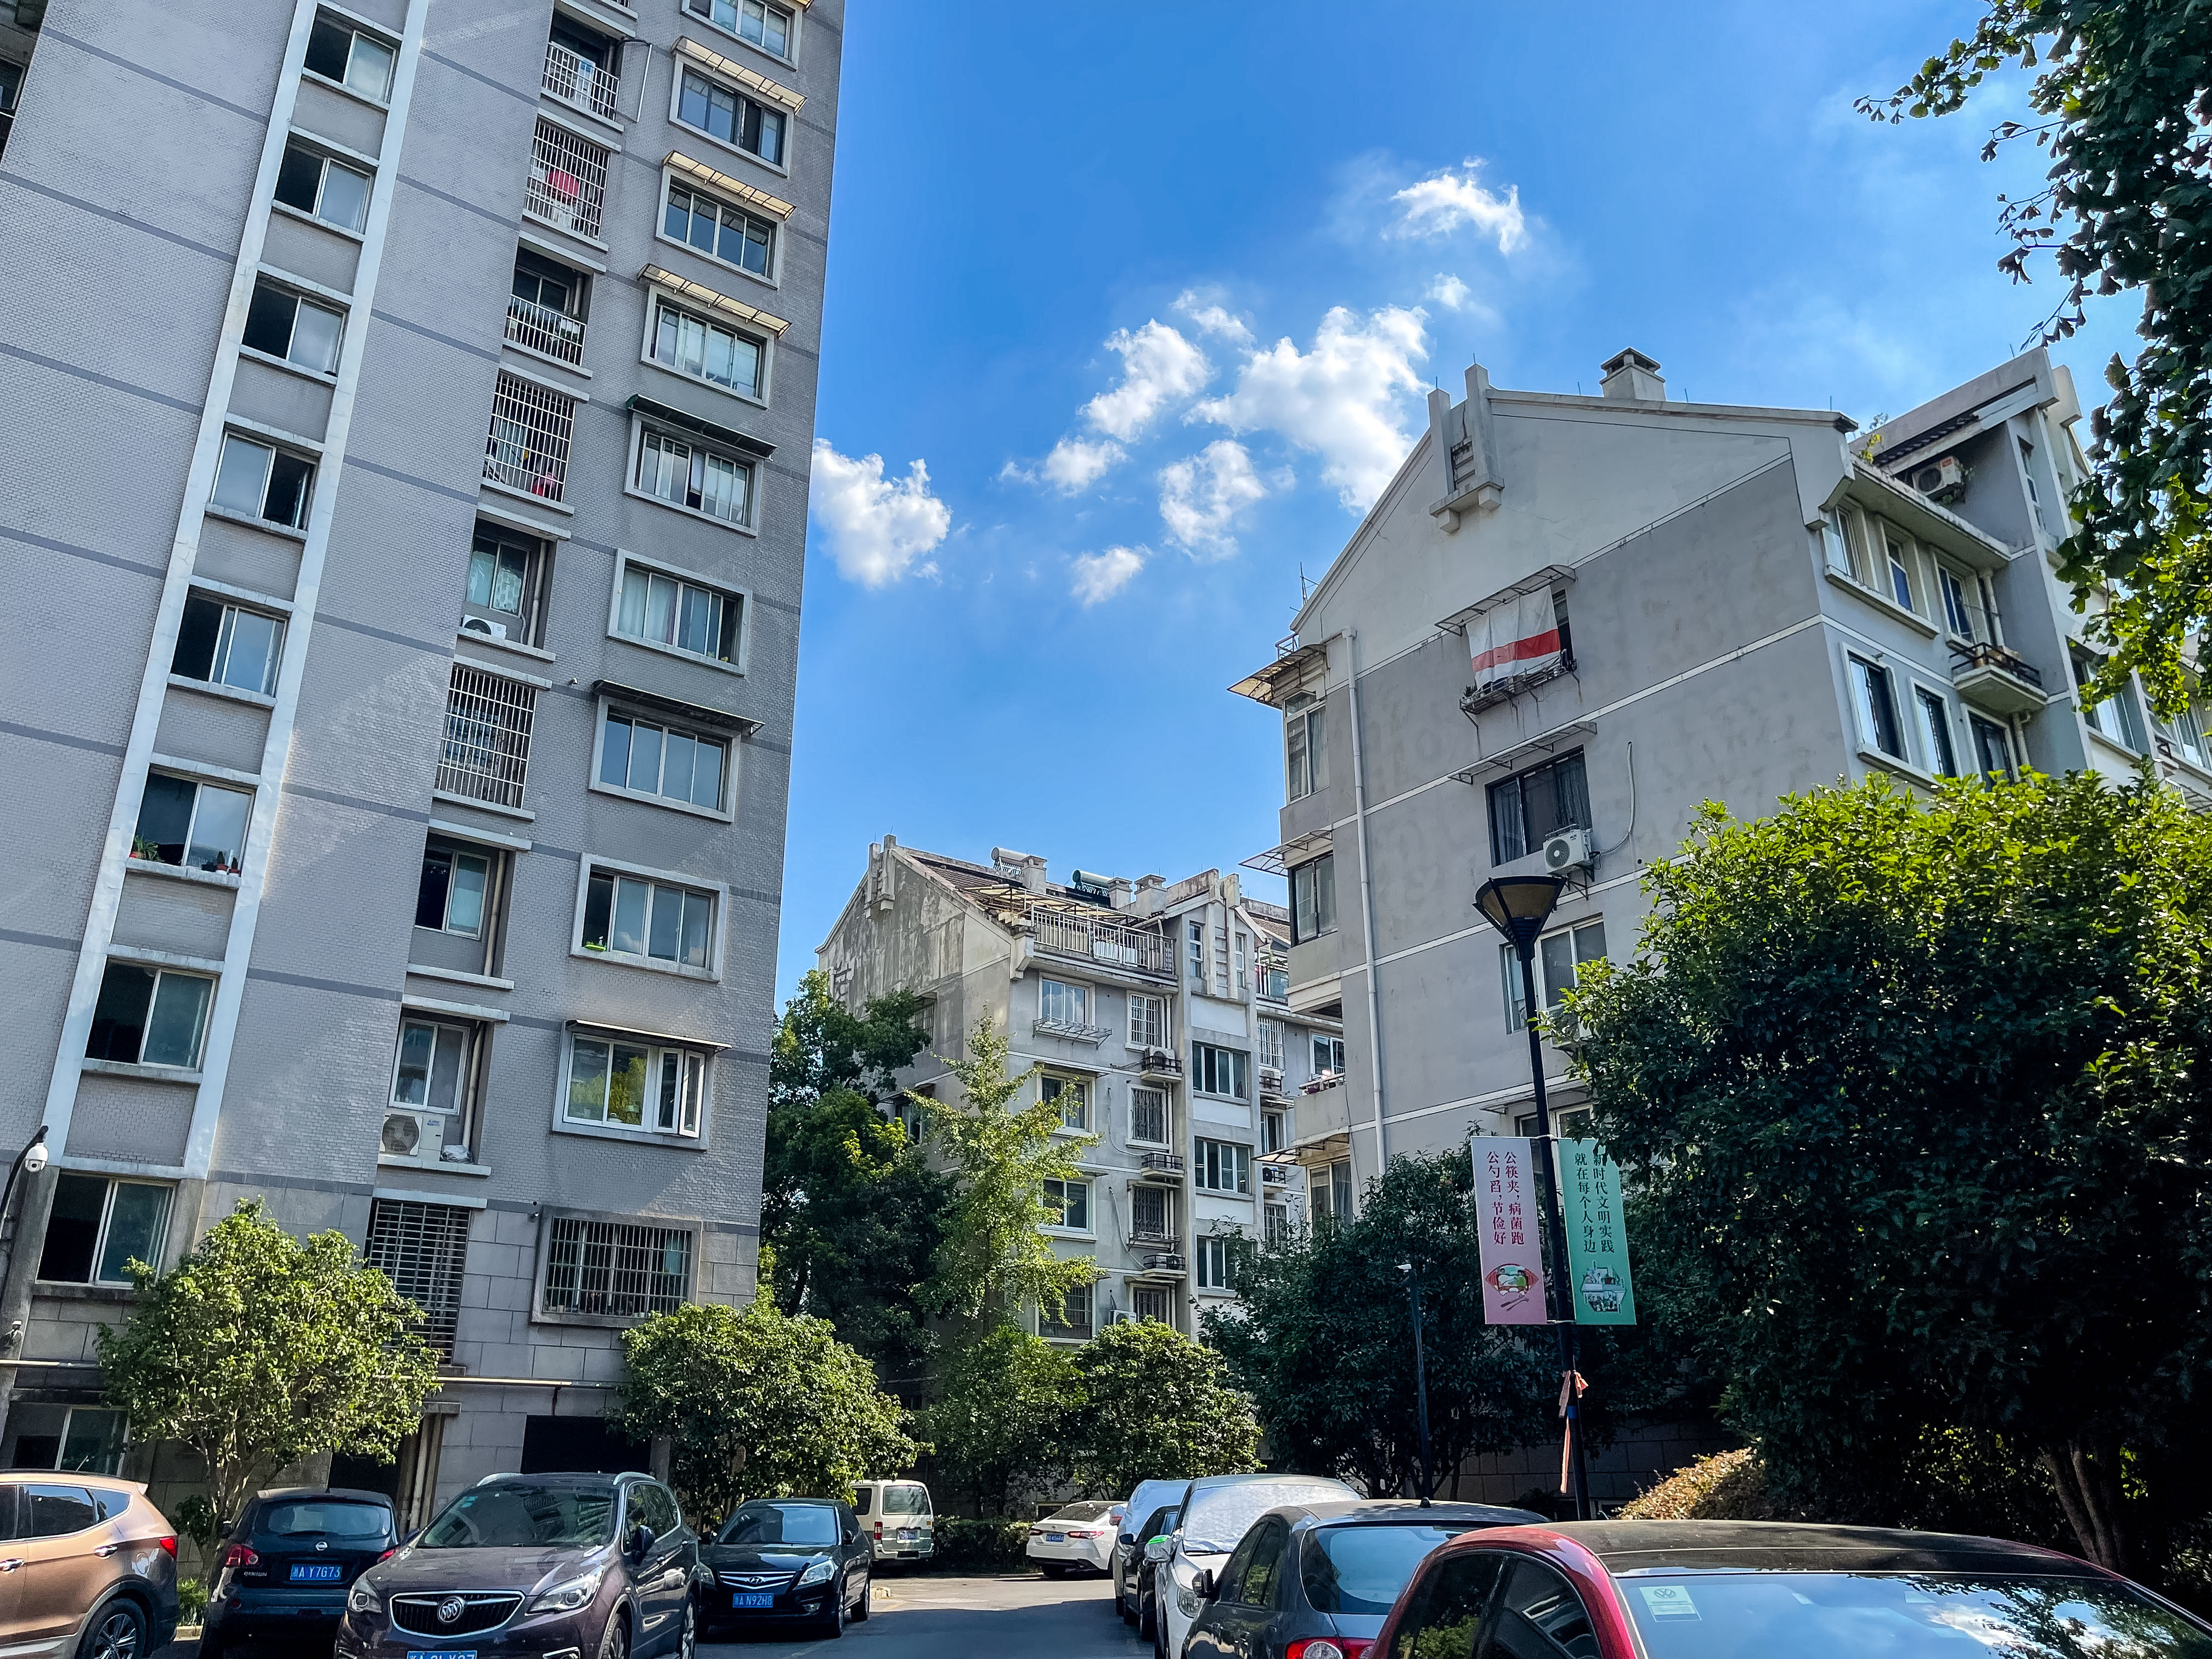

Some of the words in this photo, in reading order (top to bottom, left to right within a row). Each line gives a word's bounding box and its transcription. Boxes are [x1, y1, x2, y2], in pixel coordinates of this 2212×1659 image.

[1575, 1153, 1597, 1253] 就在每个人身边
